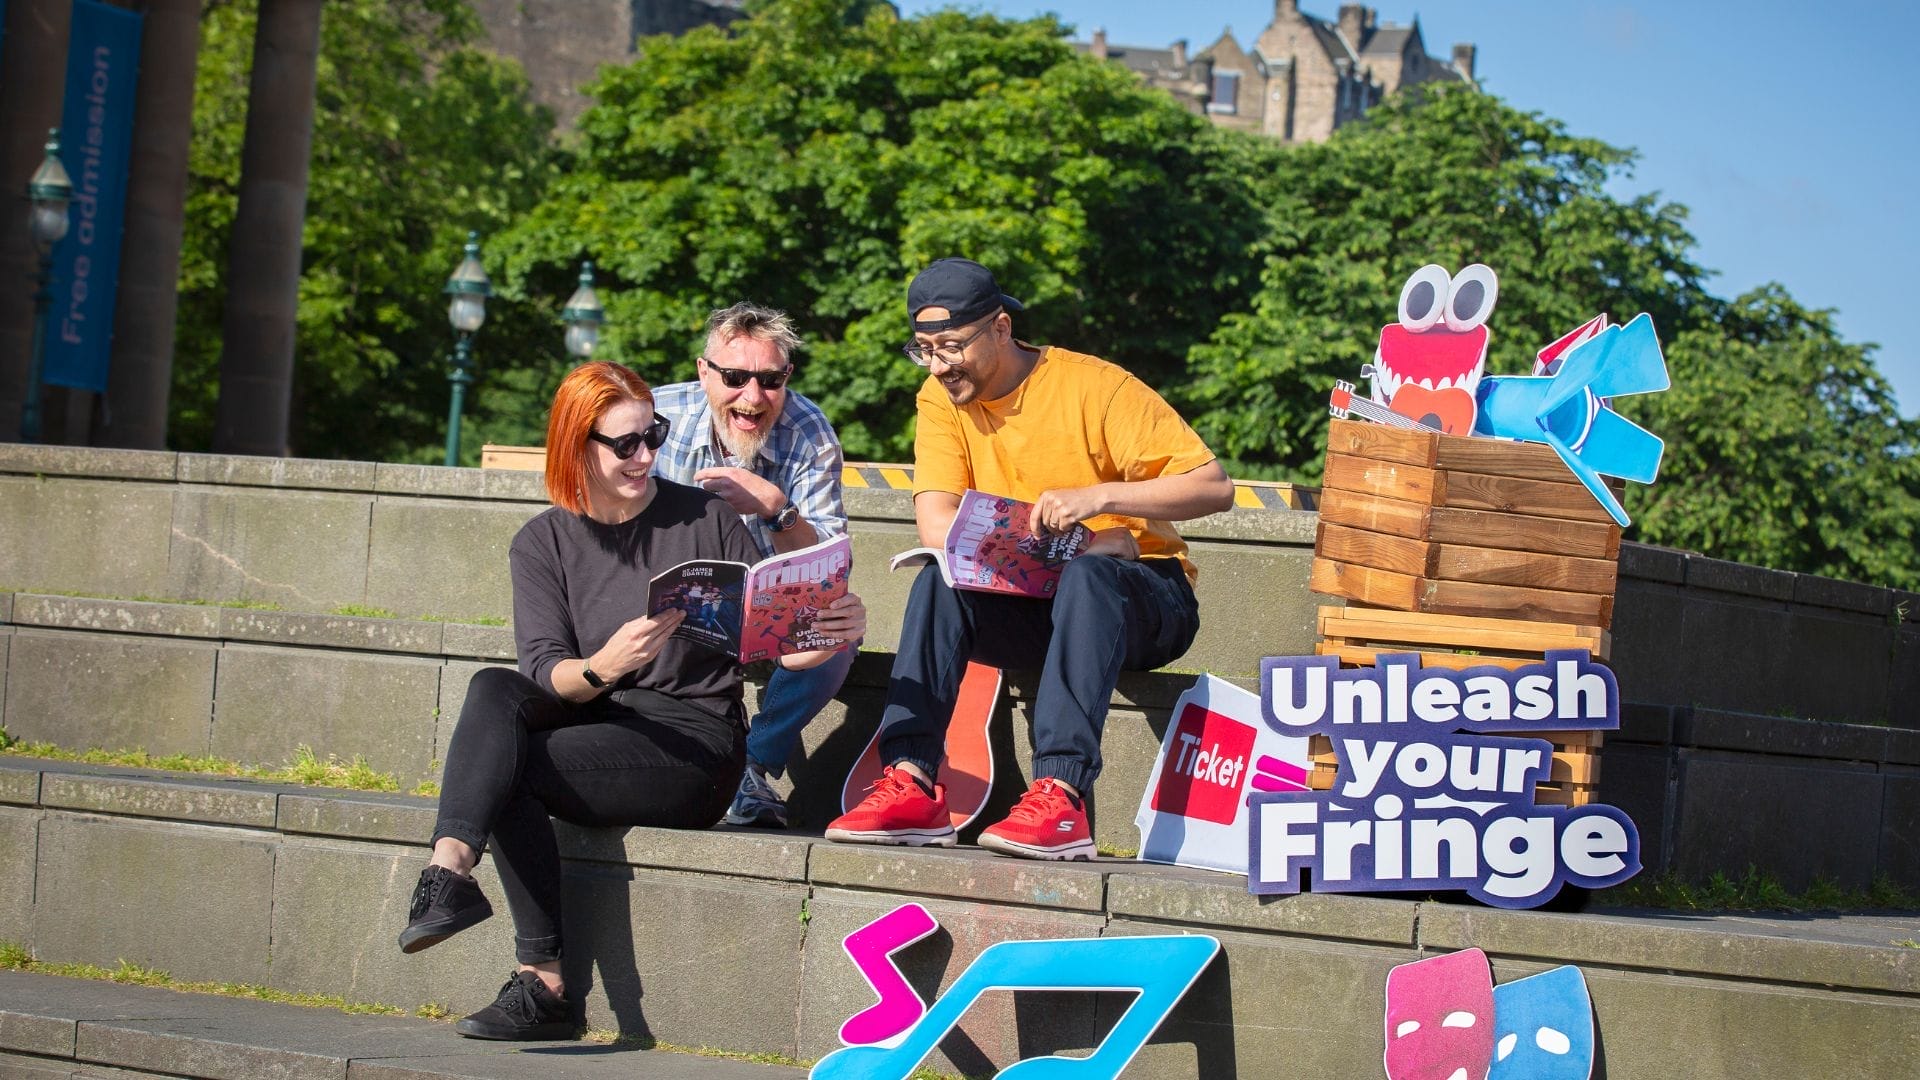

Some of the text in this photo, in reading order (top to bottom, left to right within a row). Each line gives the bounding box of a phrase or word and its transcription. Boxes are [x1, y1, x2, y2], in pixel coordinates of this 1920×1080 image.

[61, 45, 111, 345] Free admission
[758, 550, 845, 592] fringe
[1047, 536, 1060, 559] Unle
[1062, 526, 1083, 561] Fringe
[1271, 660, 1608, 727] Unleash
[1175, 732, 1244, 789] Ticket
[1342, 738, 1541, 798] your
[1259, 793, 1628, 898] Fringe
